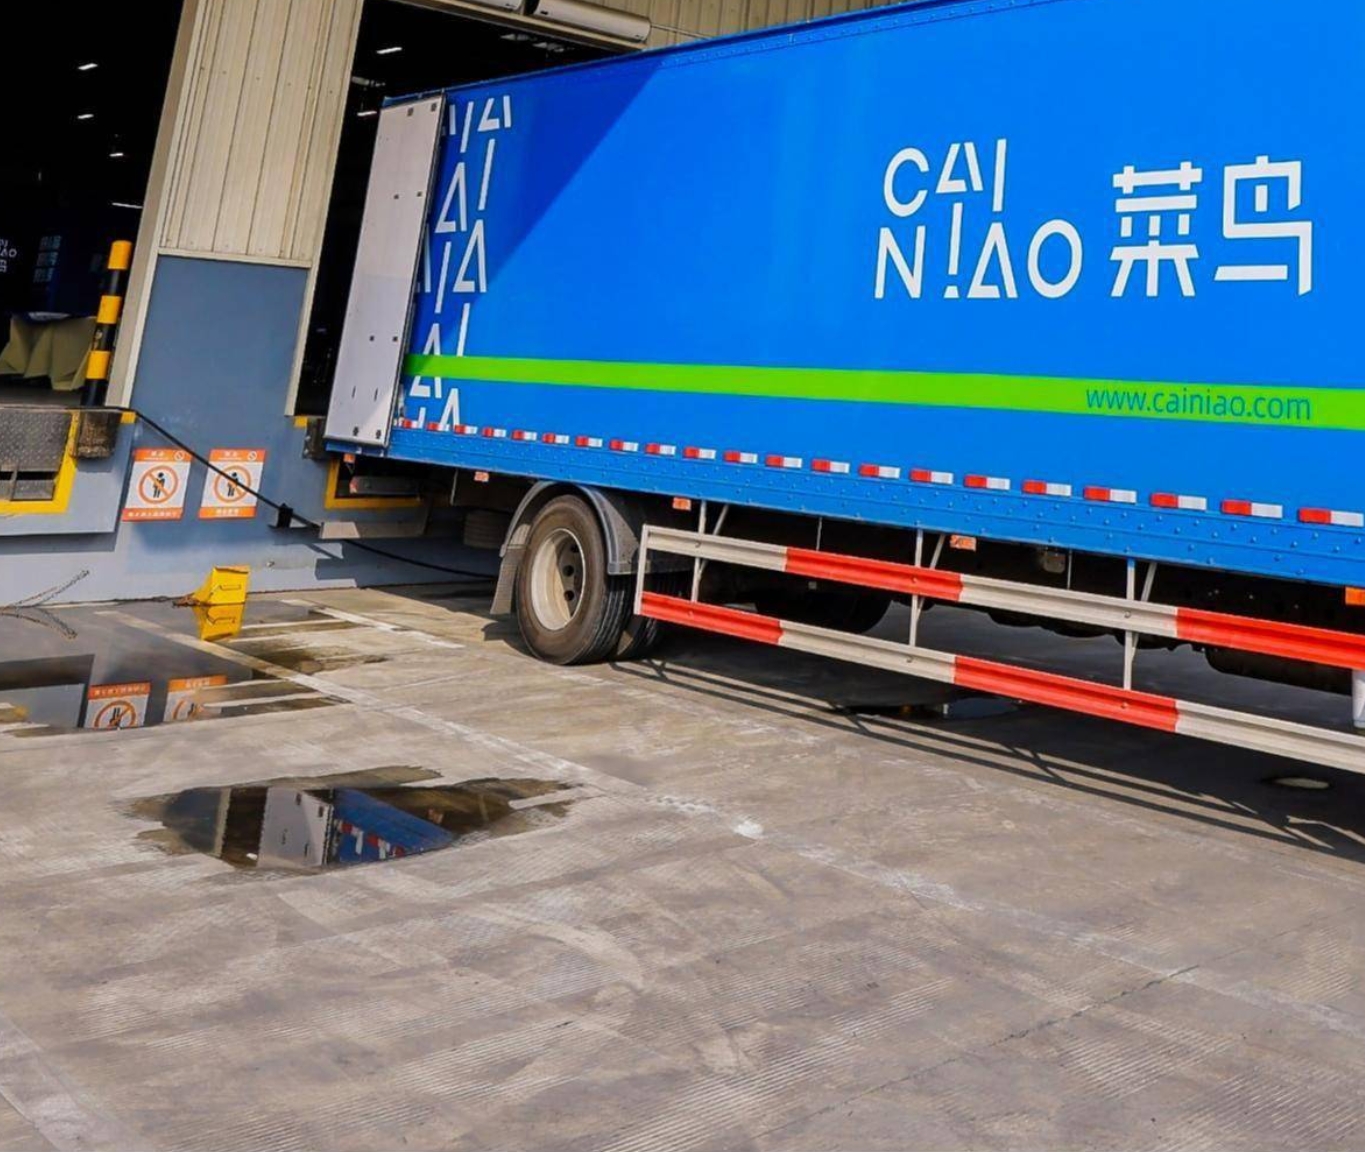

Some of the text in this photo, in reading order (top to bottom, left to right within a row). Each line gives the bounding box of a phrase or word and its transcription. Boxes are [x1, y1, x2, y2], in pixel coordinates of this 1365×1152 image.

[883, 138, 1007, 217] CAI
[1110, 155, 1314, 297] 菜鸟
[1086, 386, 1311, 422] www.cainiao.com
